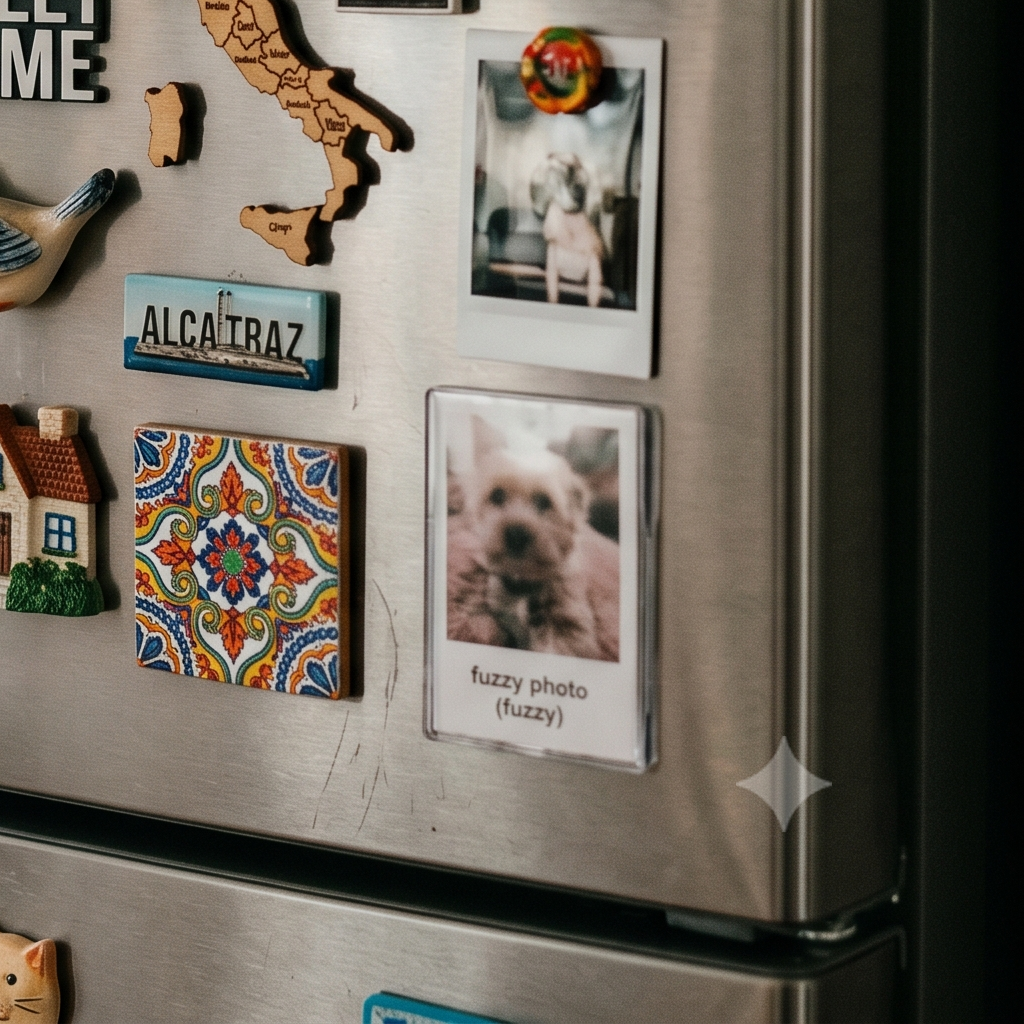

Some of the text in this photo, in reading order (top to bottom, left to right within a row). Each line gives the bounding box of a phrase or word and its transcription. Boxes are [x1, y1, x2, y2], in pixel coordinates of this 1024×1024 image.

[141, 305, 304, 363] ALCATRAZ
[471, 665, 588, 699] fuzzy photo
[496, 697, 563, 729] (fuzzy)
